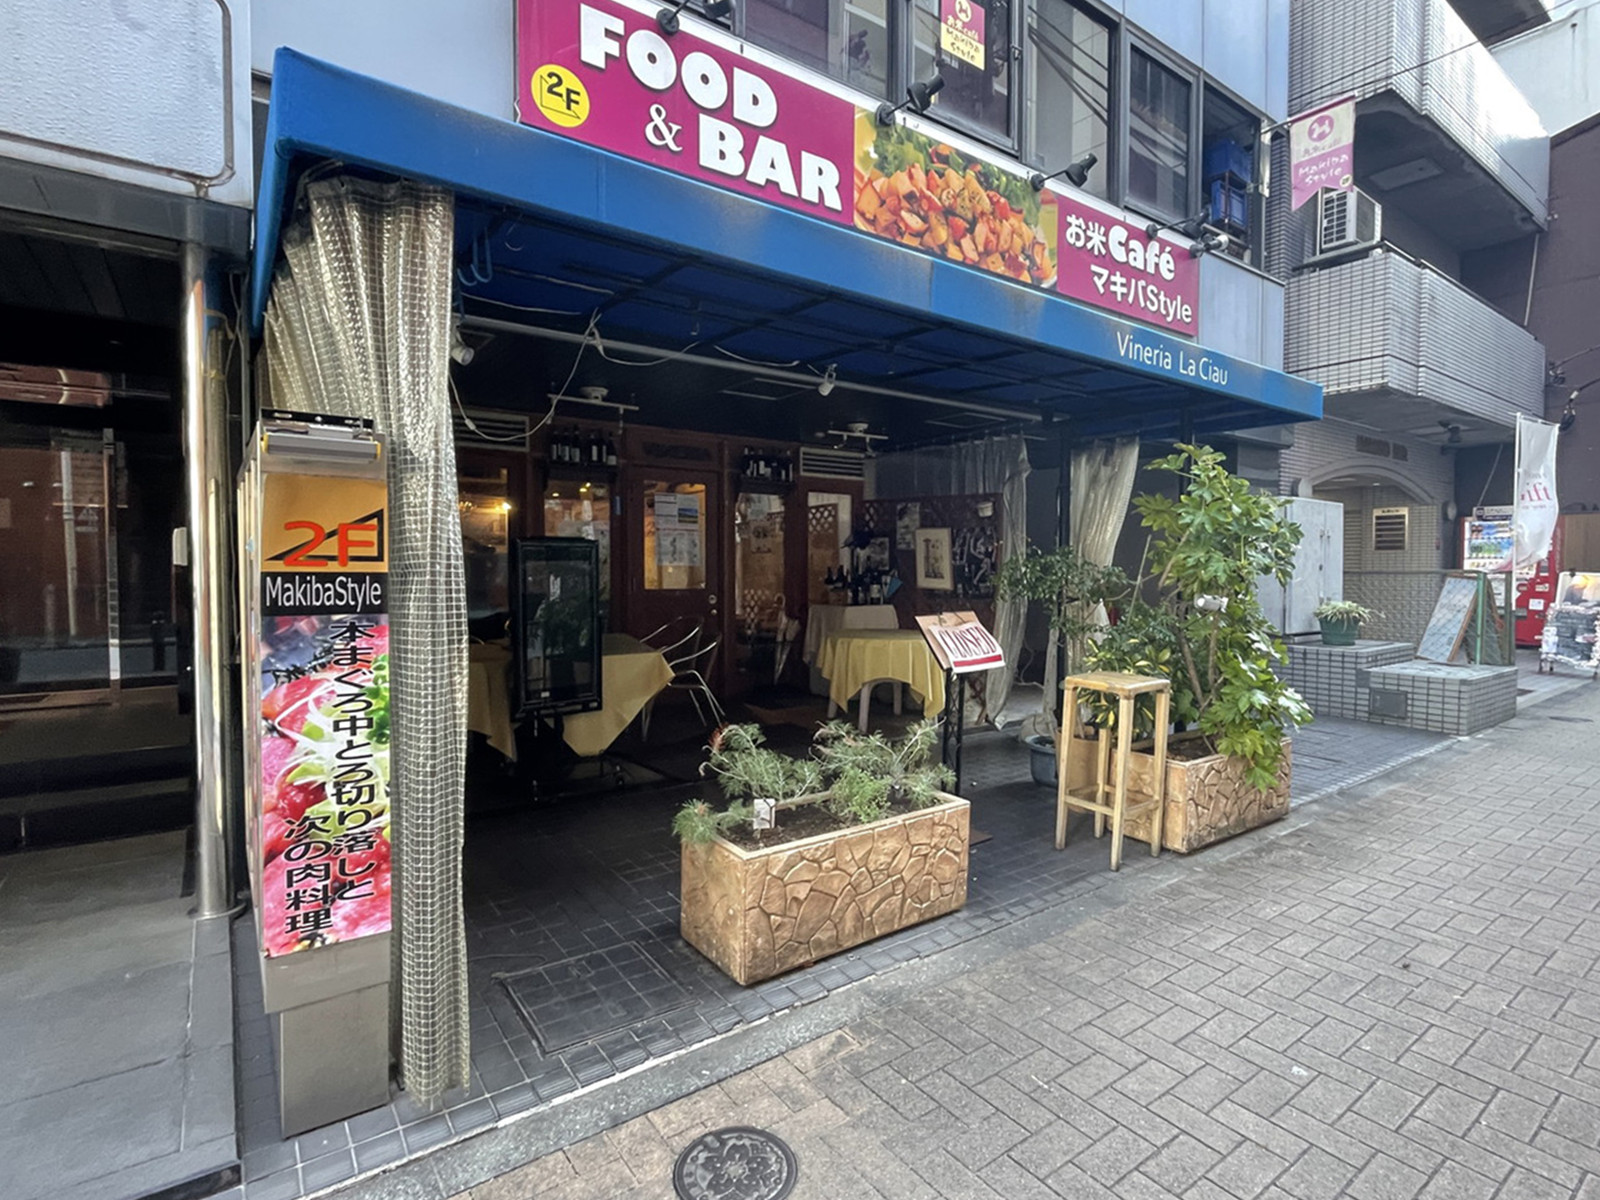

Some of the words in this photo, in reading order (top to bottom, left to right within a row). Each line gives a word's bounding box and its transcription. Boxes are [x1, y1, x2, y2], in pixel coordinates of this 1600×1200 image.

[546, 71, 582, 111] 2F
[579, 3, 778, 127] FOOD
[644, 103, 683, 152] &
[699, 113, 843, 211] BAR
[1090, 264, 1192, 323] マキバStyle
[1117, 331, 1172, 369] Vineria
[1179, 350, 1196, 376] La
[1199, 357, 1228, 385] Ciau
[283, 520, 378, 567] 2F
[265, 575, 382, 612] MakibaStyle
[938, 626, 997, 659] CLOSED
[329, 621, 376, 901] 本まぐろ中とろ切り落しと
[284, 815, 334, 934] 次の肉料理
